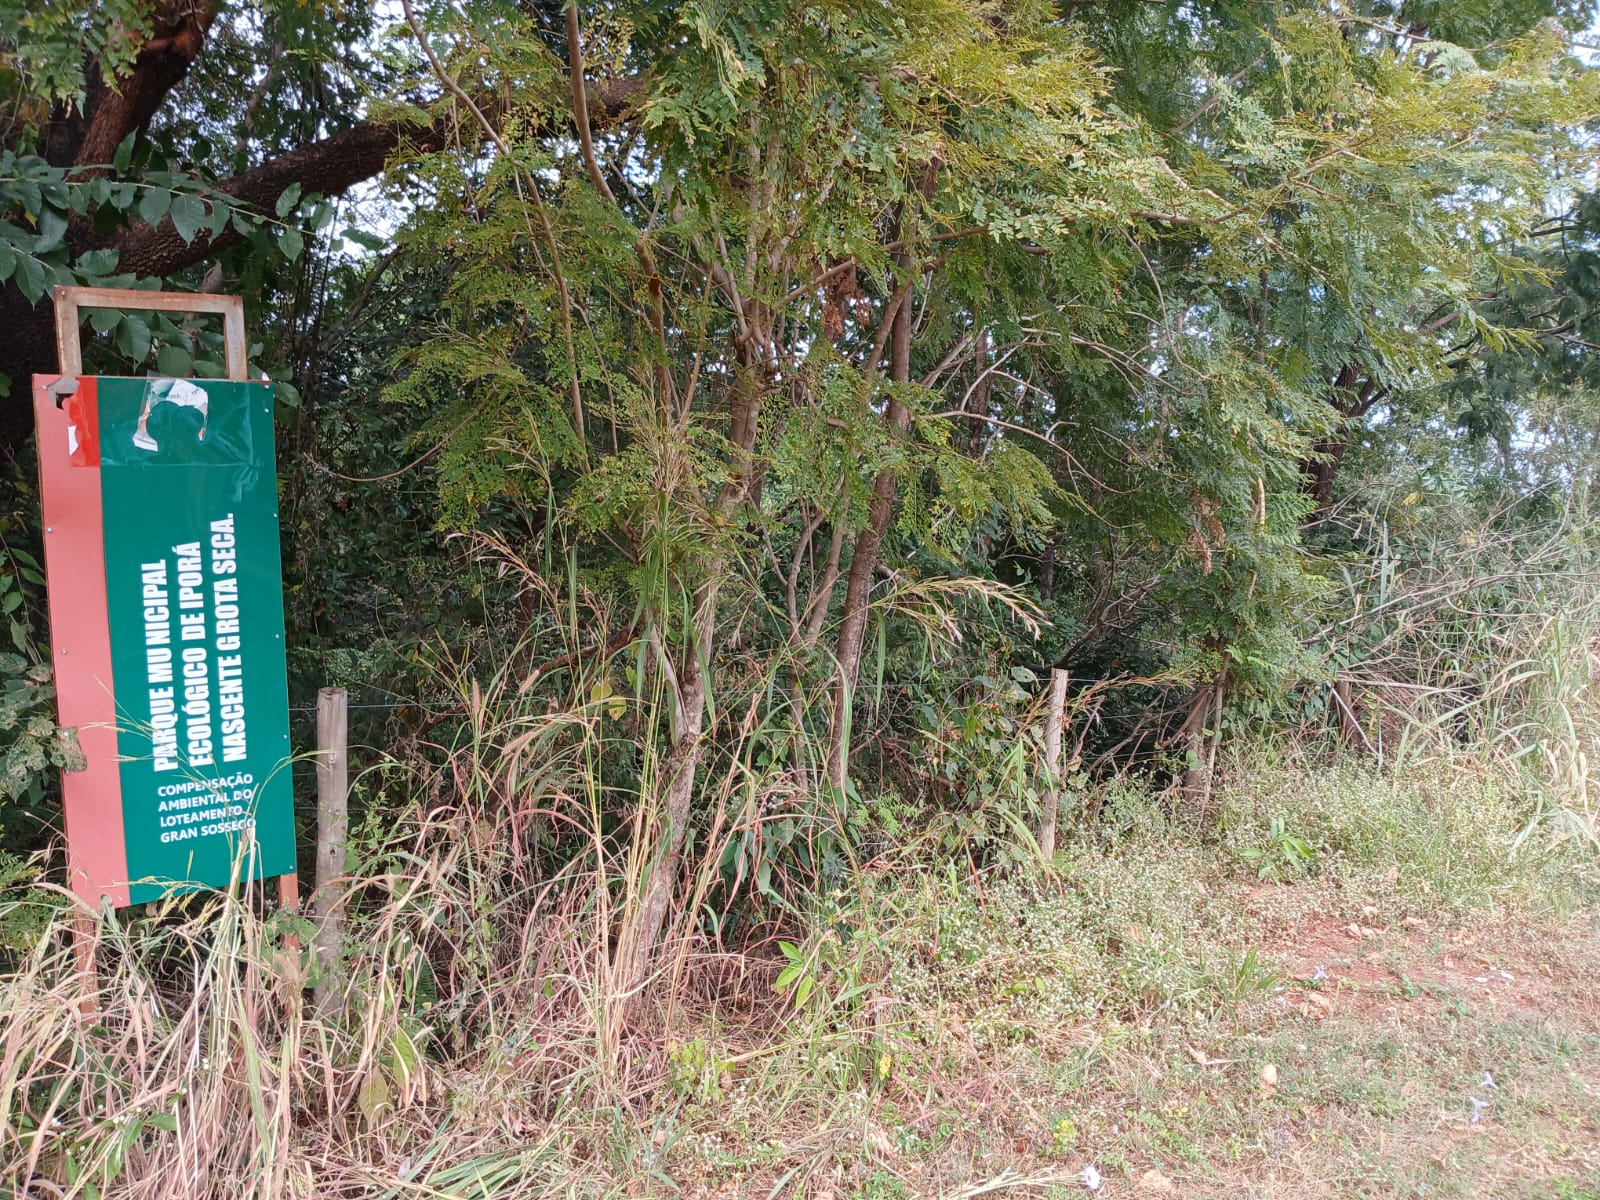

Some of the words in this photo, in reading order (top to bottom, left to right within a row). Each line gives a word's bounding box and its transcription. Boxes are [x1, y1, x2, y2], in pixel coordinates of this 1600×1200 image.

[172, 541, 203, 609] IPORÁ
[210, 512, 236, 574] SECA.
[141, 559, 173, 683] MUNICIPAL
[180, 612, 205, 640] DE
[213, 577, 241, 651] GROTA
[149, 686, 178, 772] PARQUE
[181, 647, 213, 767] ECOLÓGICO
[217, 654, 247, 762] NASCENTE
[157, 772, 253, 797] COMPENSAÇÃO
[158, 792, 230, 812] AMBIENTAL
[233, 788, 252, 801] DO
[160, 805, 243, 828] LOTEAMENTO
[160, 827, 198, 844] GRAN
[201, 818, 256, 837] SOSSEGO
